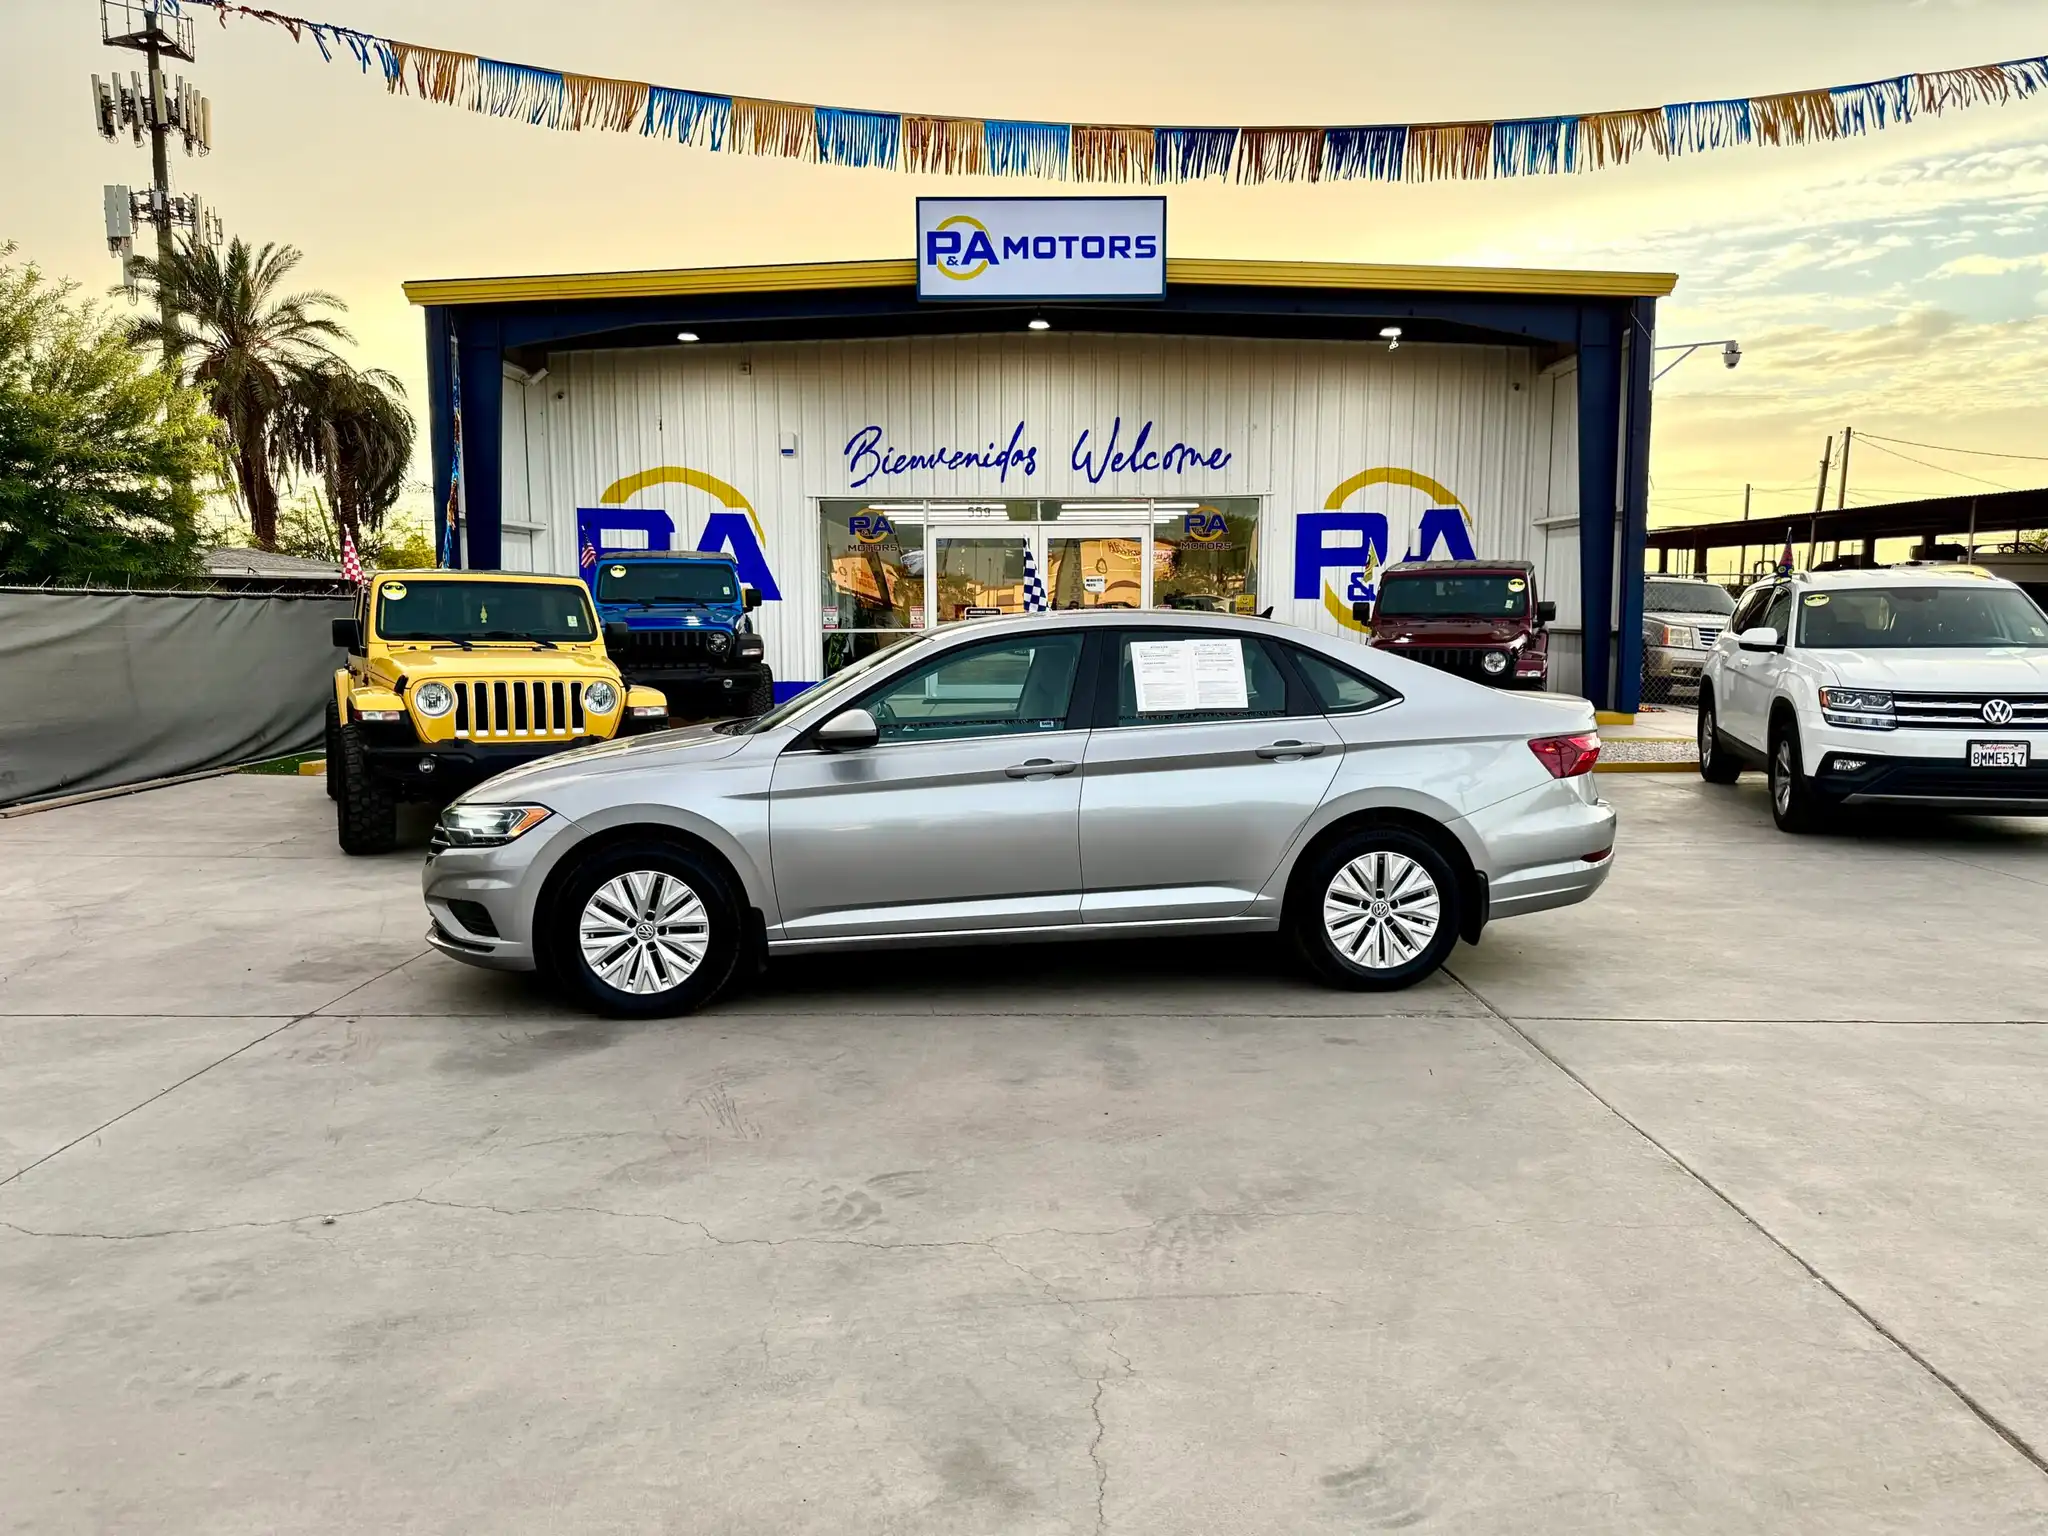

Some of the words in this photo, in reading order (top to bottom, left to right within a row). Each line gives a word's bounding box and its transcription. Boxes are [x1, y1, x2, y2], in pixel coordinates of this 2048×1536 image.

[926, 231, 1000, 266] P&A
[1003, 235, 1156, 259] MOTORS
[844, 420, 1038, 488] Bienvenidos
[1072, 416, 1232, 484] Welcome
[847, 543, 898, 552] MOTORS
[1181, 541, 1232, 550] MOTORS
[1981, 743, 2016, 752] California
[1973, 752, 2025, 765] 8MME517
